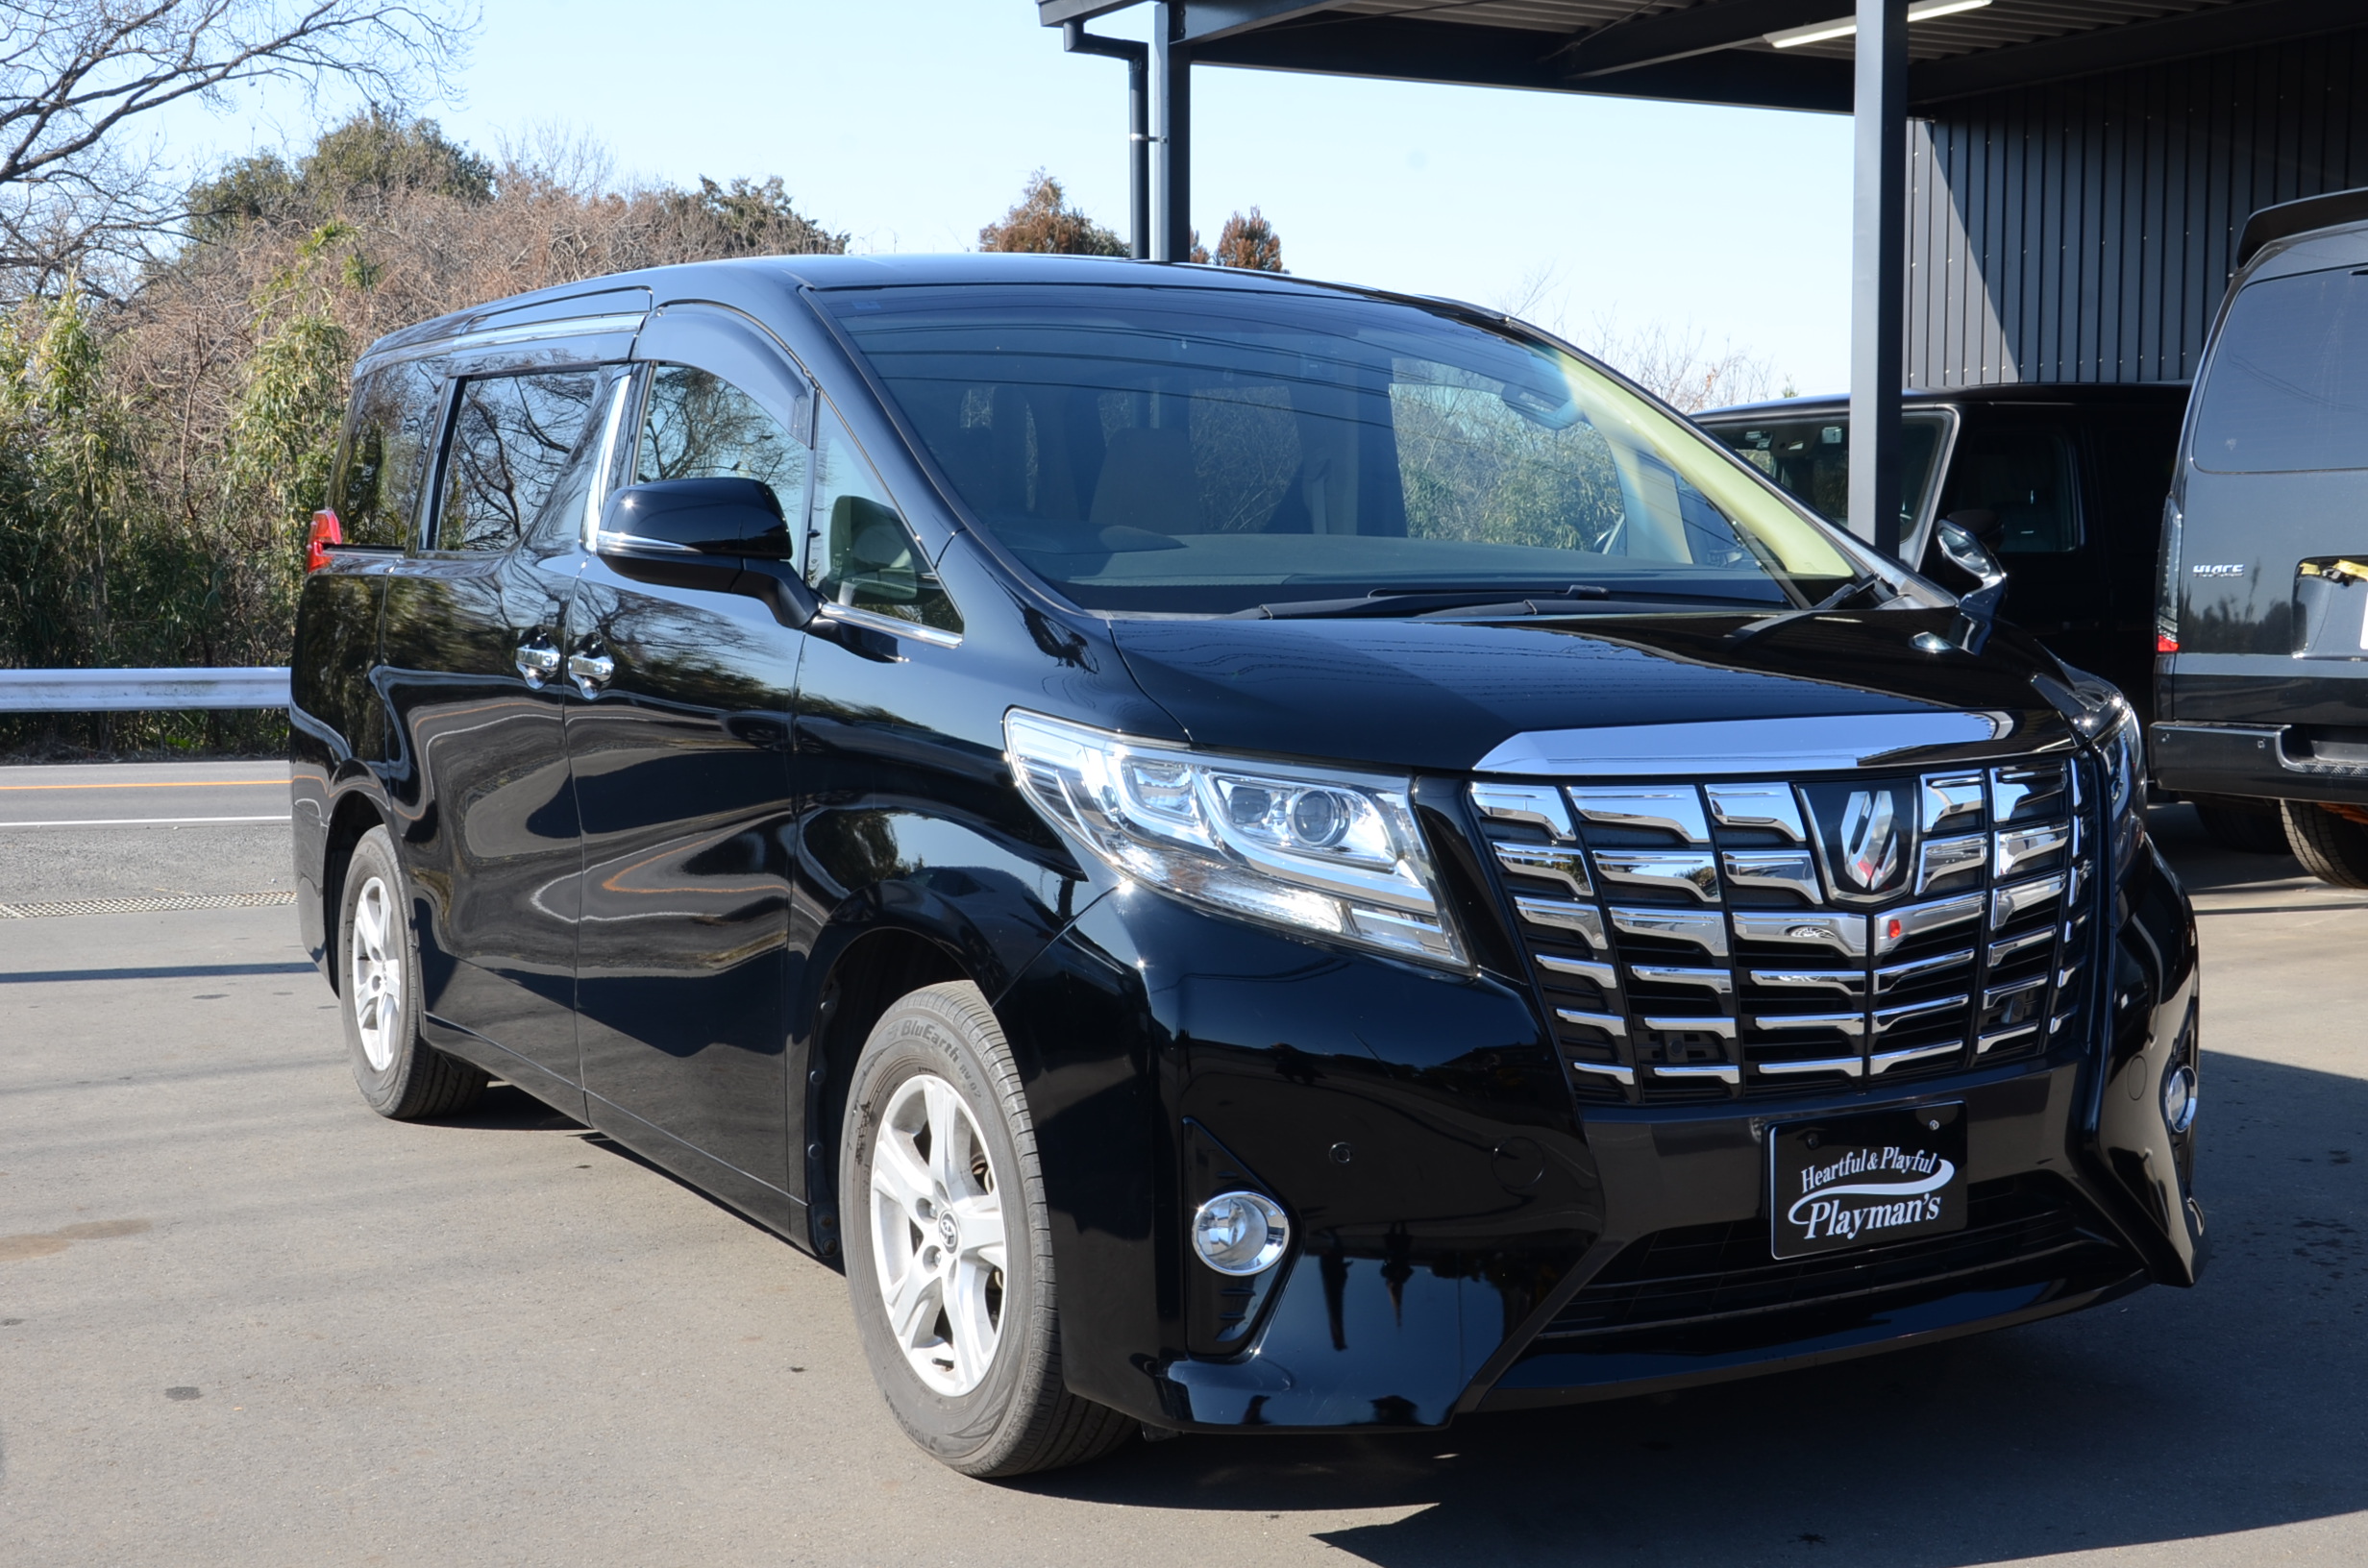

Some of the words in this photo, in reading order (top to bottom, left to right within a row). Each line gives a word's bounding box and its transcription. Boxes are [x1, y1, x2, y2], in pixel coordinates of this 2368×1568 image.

[900, 1019, 959, 1063] BluEarth
[1800, 1148, 1867, 1194] Heartful
[1867, 1151, 1878, 1171] &
[1879, 1146, 1937, 1174] Playful
[1803, 1192, 1941, 1240] Playman's
